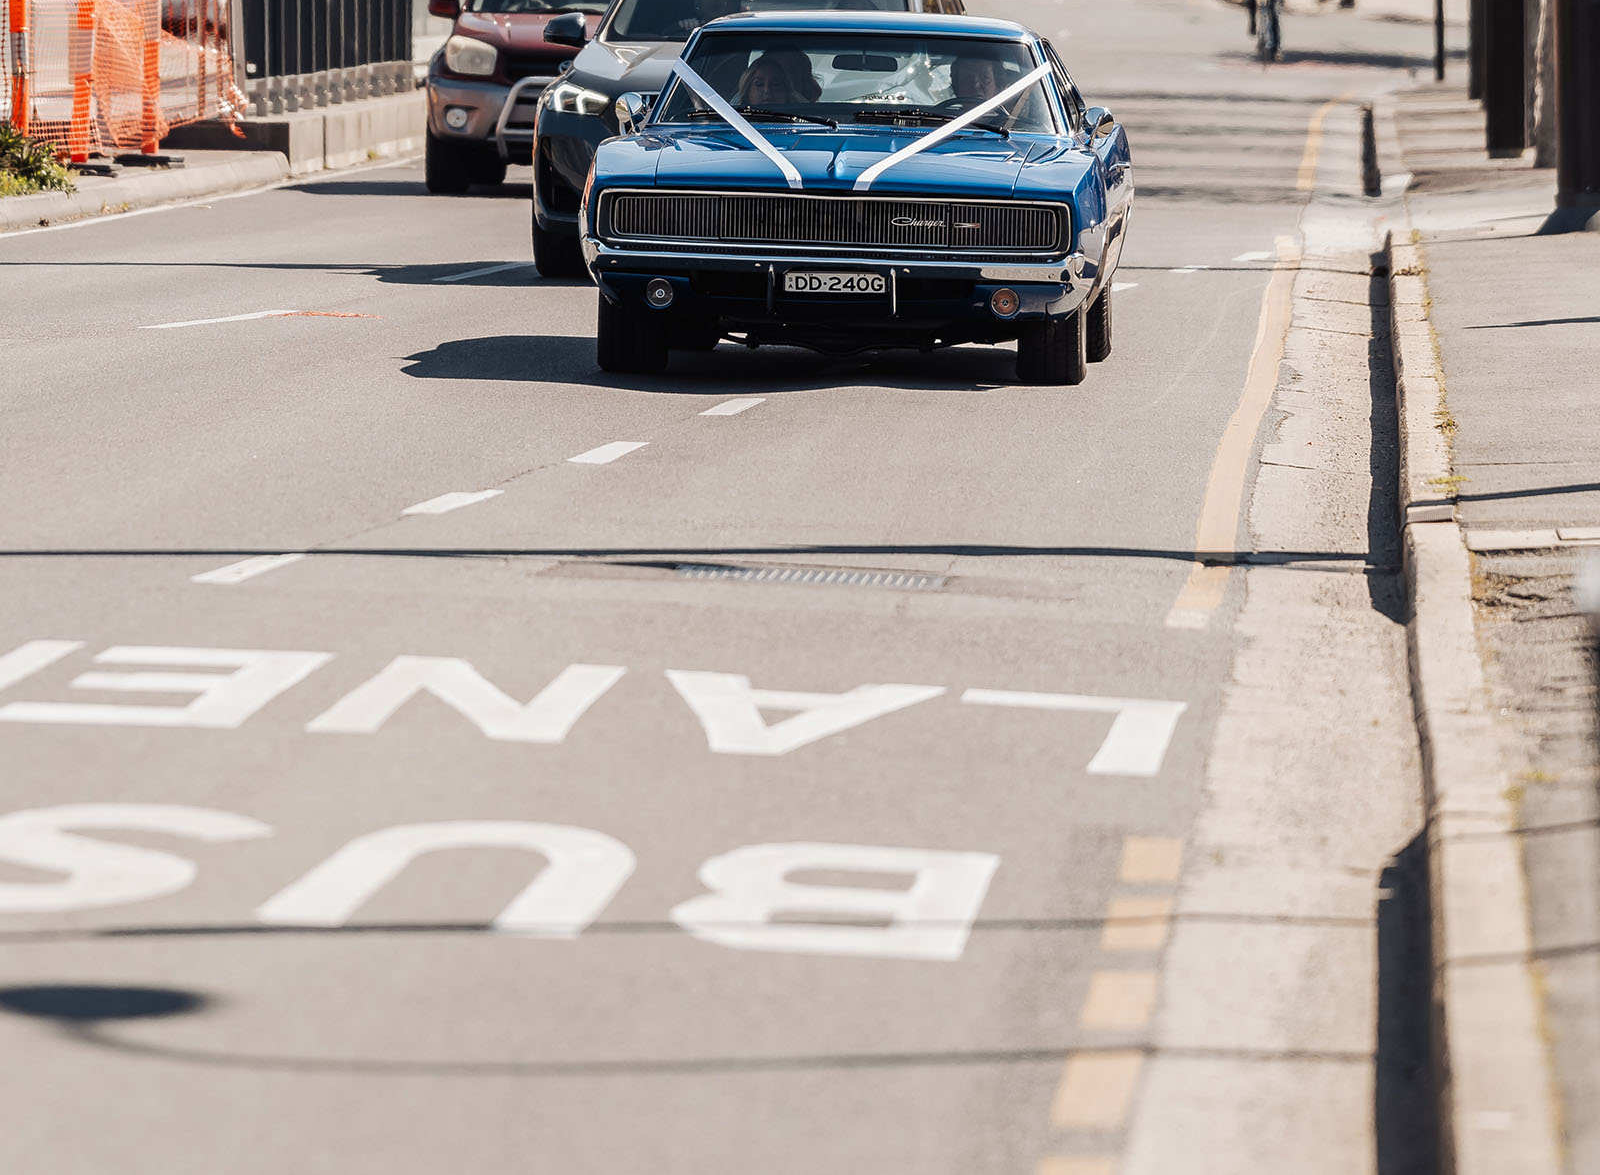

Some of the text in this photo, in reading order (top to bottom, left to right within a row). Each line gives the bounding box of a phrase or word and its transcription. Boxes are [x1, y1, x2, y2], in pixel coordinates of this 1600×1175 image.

[890, 216, 947, 230] Charger
[0, 646, 1188, 777] LANE
[0, 802, 1001, 962] BUS
